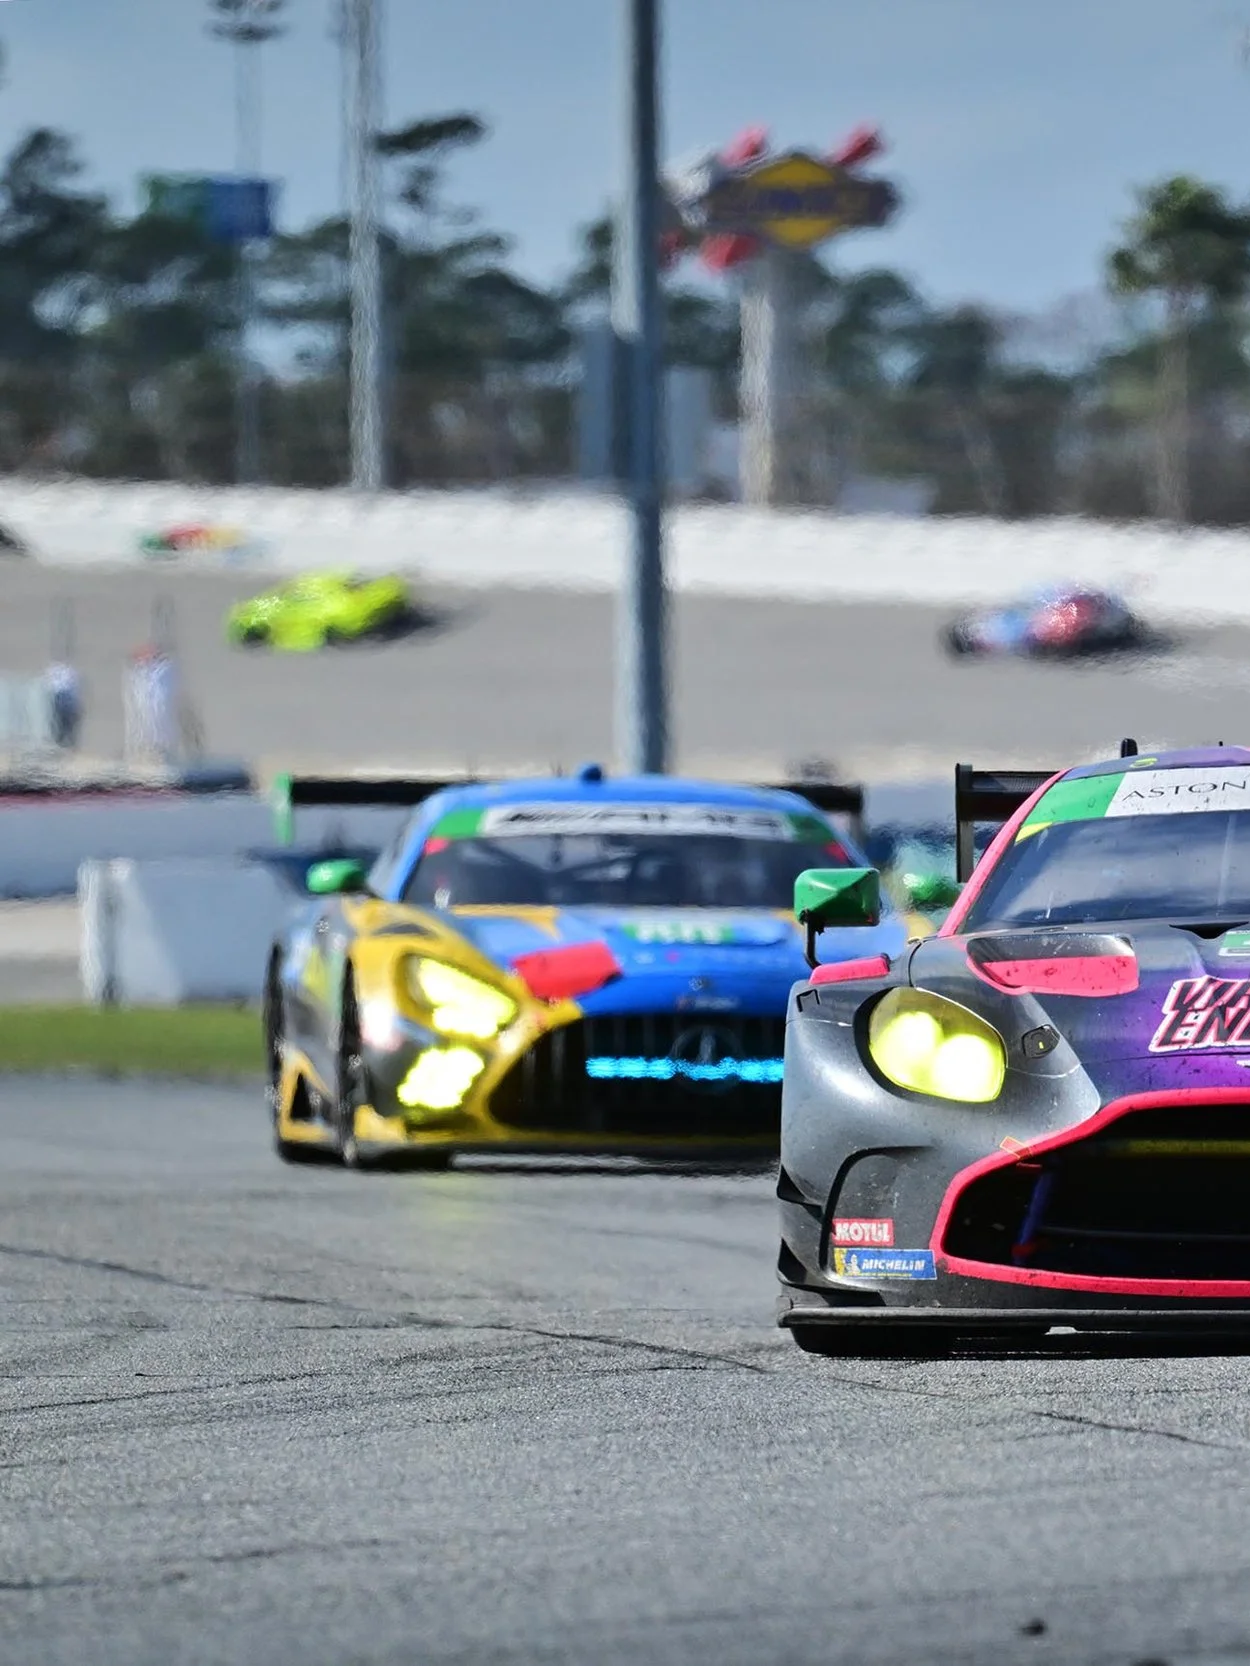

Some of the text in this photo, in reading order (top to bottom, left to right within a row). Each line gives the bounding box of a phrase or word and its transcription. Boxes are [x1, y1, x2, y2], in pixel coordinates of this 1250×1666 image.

[1122, 779, 1246, 801] ASTON
[834, 1222, 891, 1242] MOTUL
[861, 1258, 926, 1271] MICHELIN
